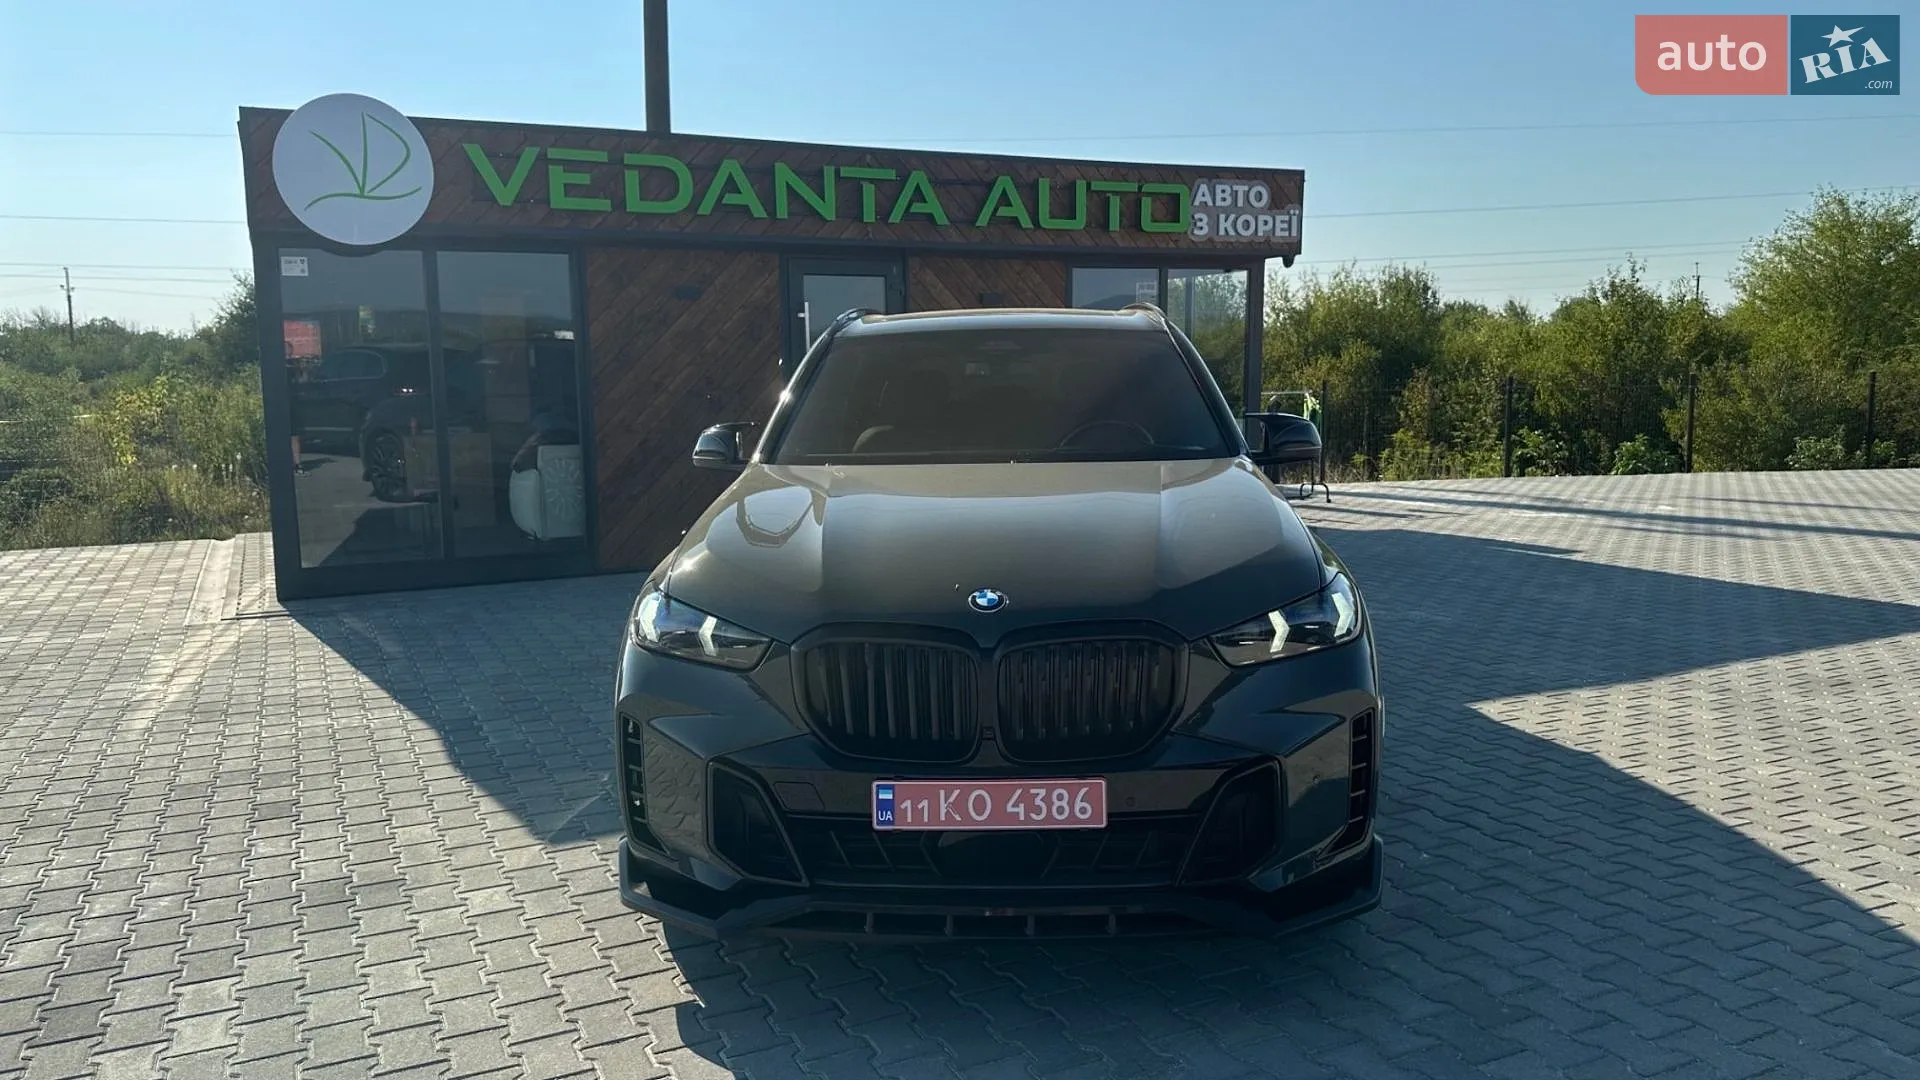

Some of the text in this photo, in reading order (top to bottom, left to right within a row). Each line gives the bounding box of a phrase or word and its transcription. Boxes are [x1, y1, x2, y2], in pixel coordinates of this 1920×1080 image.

[462, 143, 1191, 233] VEDANTA AUTO
[1193, 183, 1269, 208] АВТО
[1218, 209, 1299, 236] КОРЕЇ
[878, 810, 893, 822] UA
[1006, 787, 1093, 821] 4386
